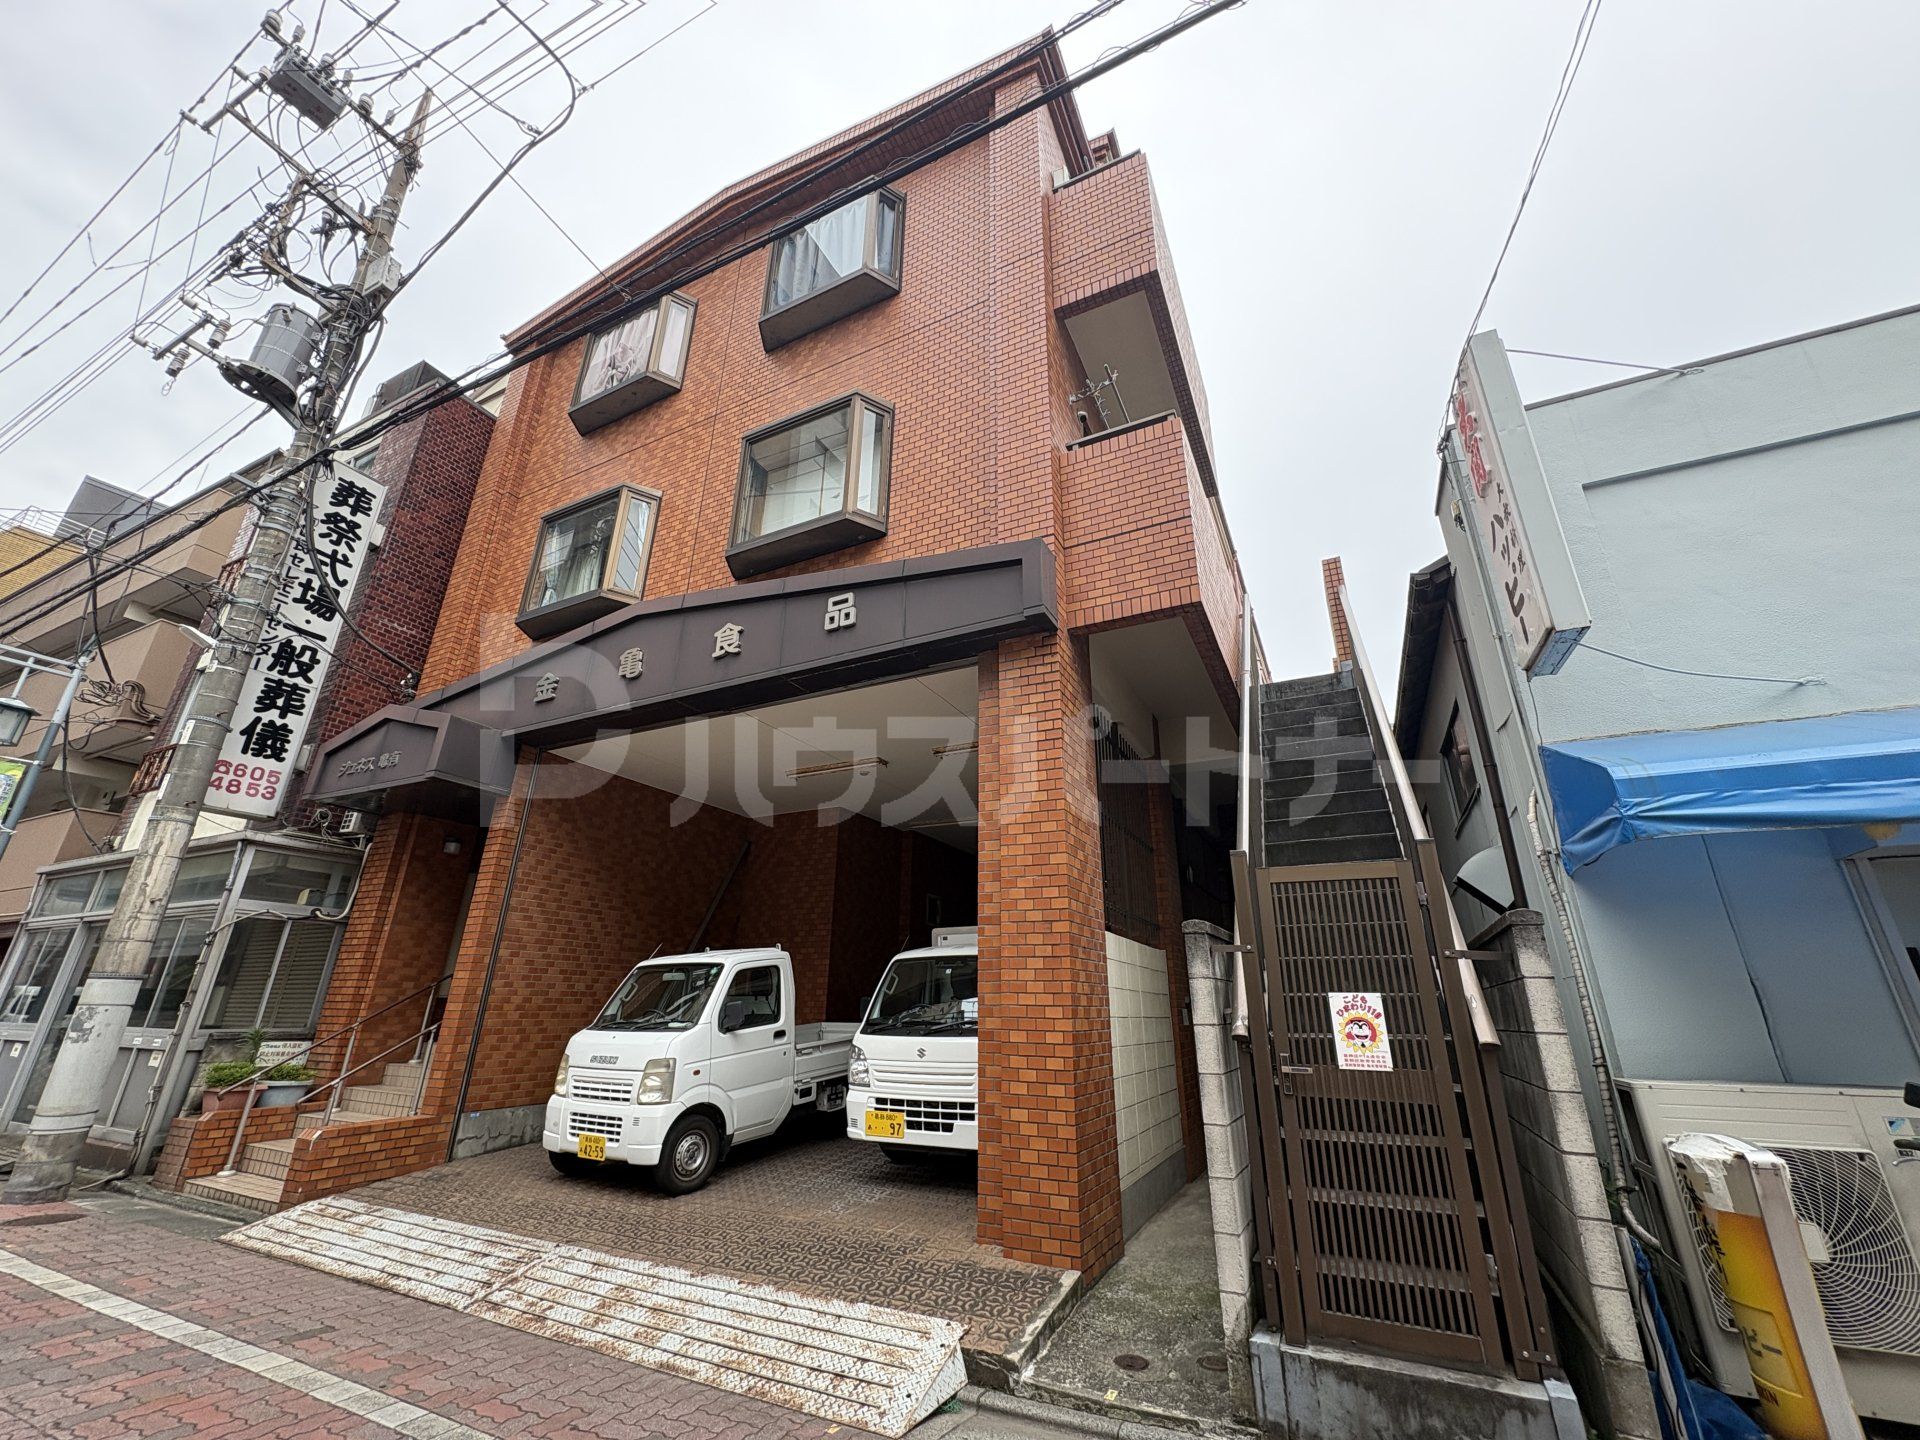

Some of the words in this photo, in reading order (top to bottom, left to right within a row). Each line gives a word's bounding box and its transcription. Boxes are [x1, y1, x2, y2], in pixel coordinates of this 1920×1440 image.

[1491, 513, 1529, 645] ハッピー
[208, 776, 277, 801] 4853
[1342, 994, 1368, 1005] こども
[590, 1055, 619, 1065] SUZUKI
